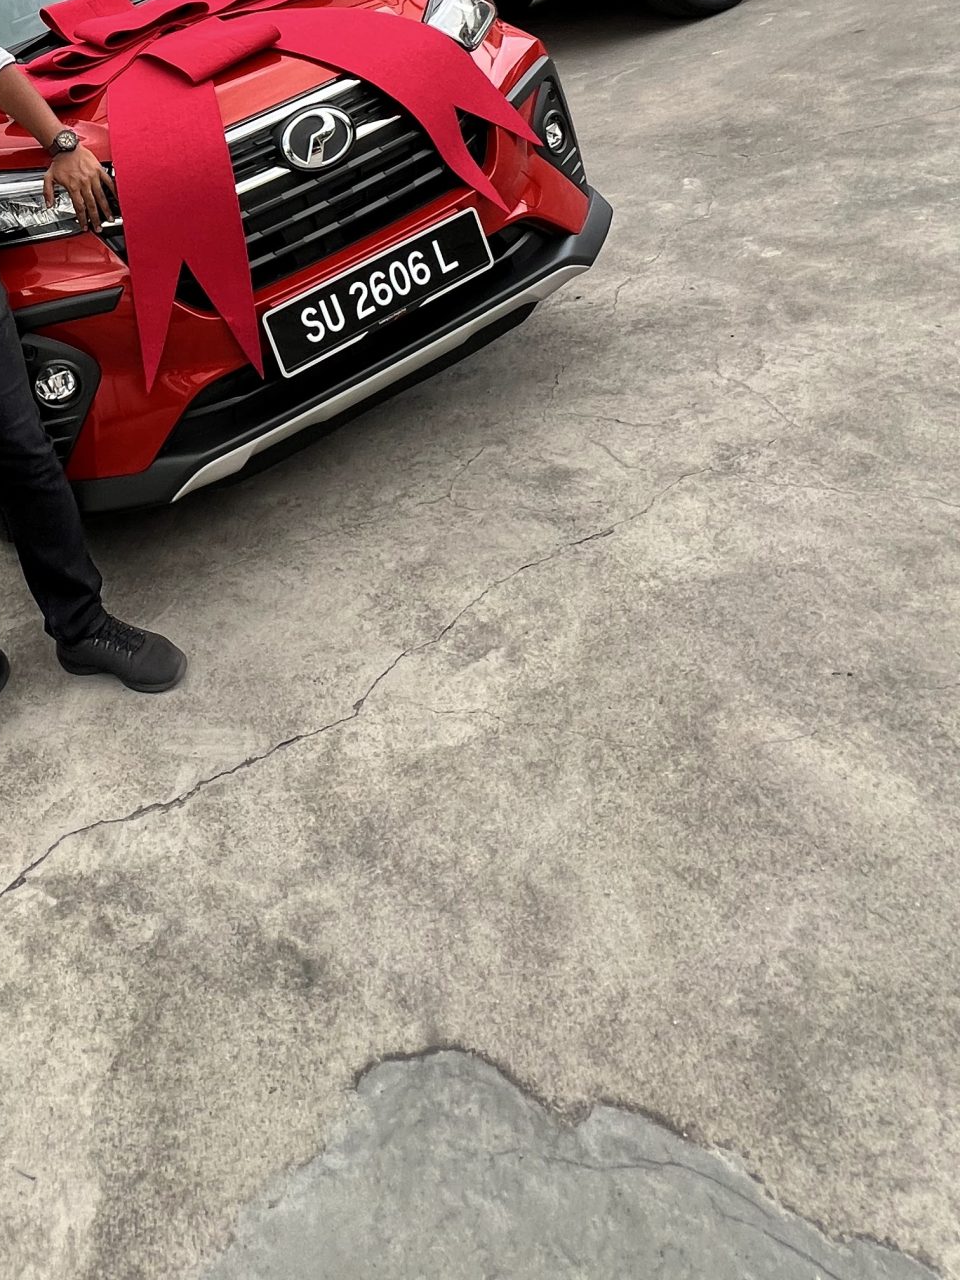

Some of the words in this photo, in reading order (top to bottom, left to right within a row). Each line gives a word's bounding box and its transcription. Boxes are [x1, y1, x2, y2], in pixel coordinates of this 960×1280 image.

[300, 293, 346, 343] SU
[348, 250, 432, 320] 2606
[431, 239, 459, 274] L
